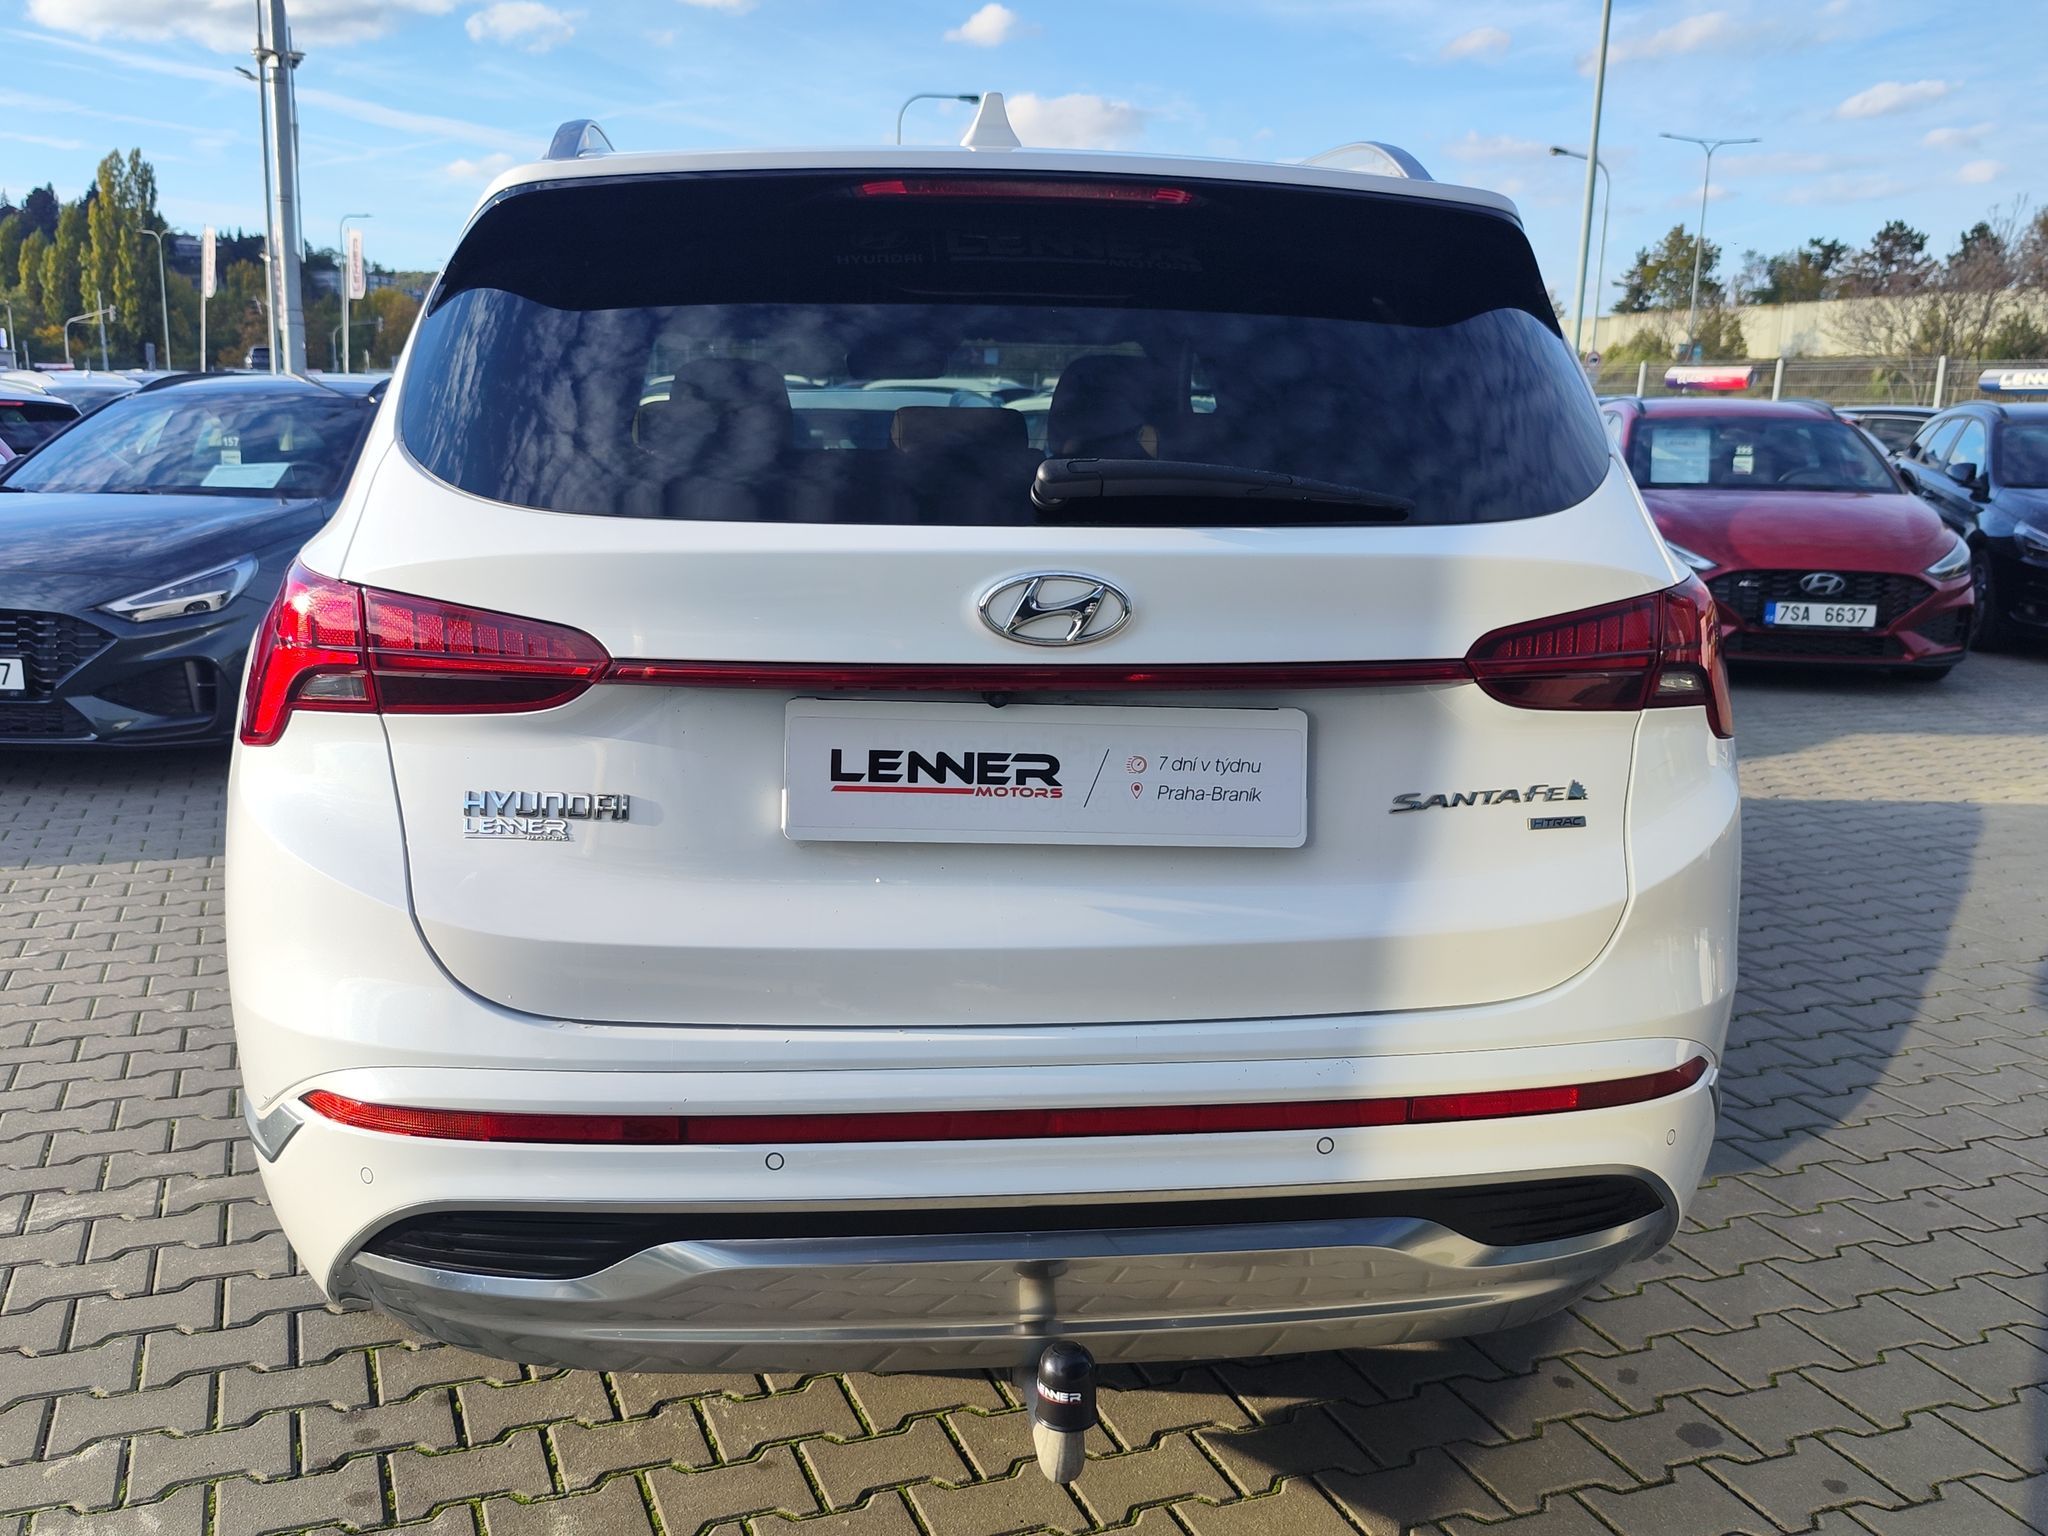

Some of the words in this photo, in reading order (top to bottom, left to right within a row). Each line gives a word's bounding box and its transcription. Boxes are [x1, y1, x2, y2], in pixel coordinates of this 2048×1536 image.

[223, 436, 239, 447] 157
[1780, 605, 1810, 622] 7SA
[1825, 607, 1867, 624] 6637
[831, 749, 1062, 786] LENNER
[1159, 756, 1168, 770] 7
[1171, 757, 1198, 772] dní
[1201, 760, 1211, 772] v
[1215, 757, 1262, 776] týdnu
[975, 786, 1063, 798] MOTORS
[1157, 785, 1262, 802] Praha-Braník
[463, 790, 630, 822] HYUNDAI
[462, 817, 569, 835] LENNER
[1533, 819, 1582, 827] HTRAC
